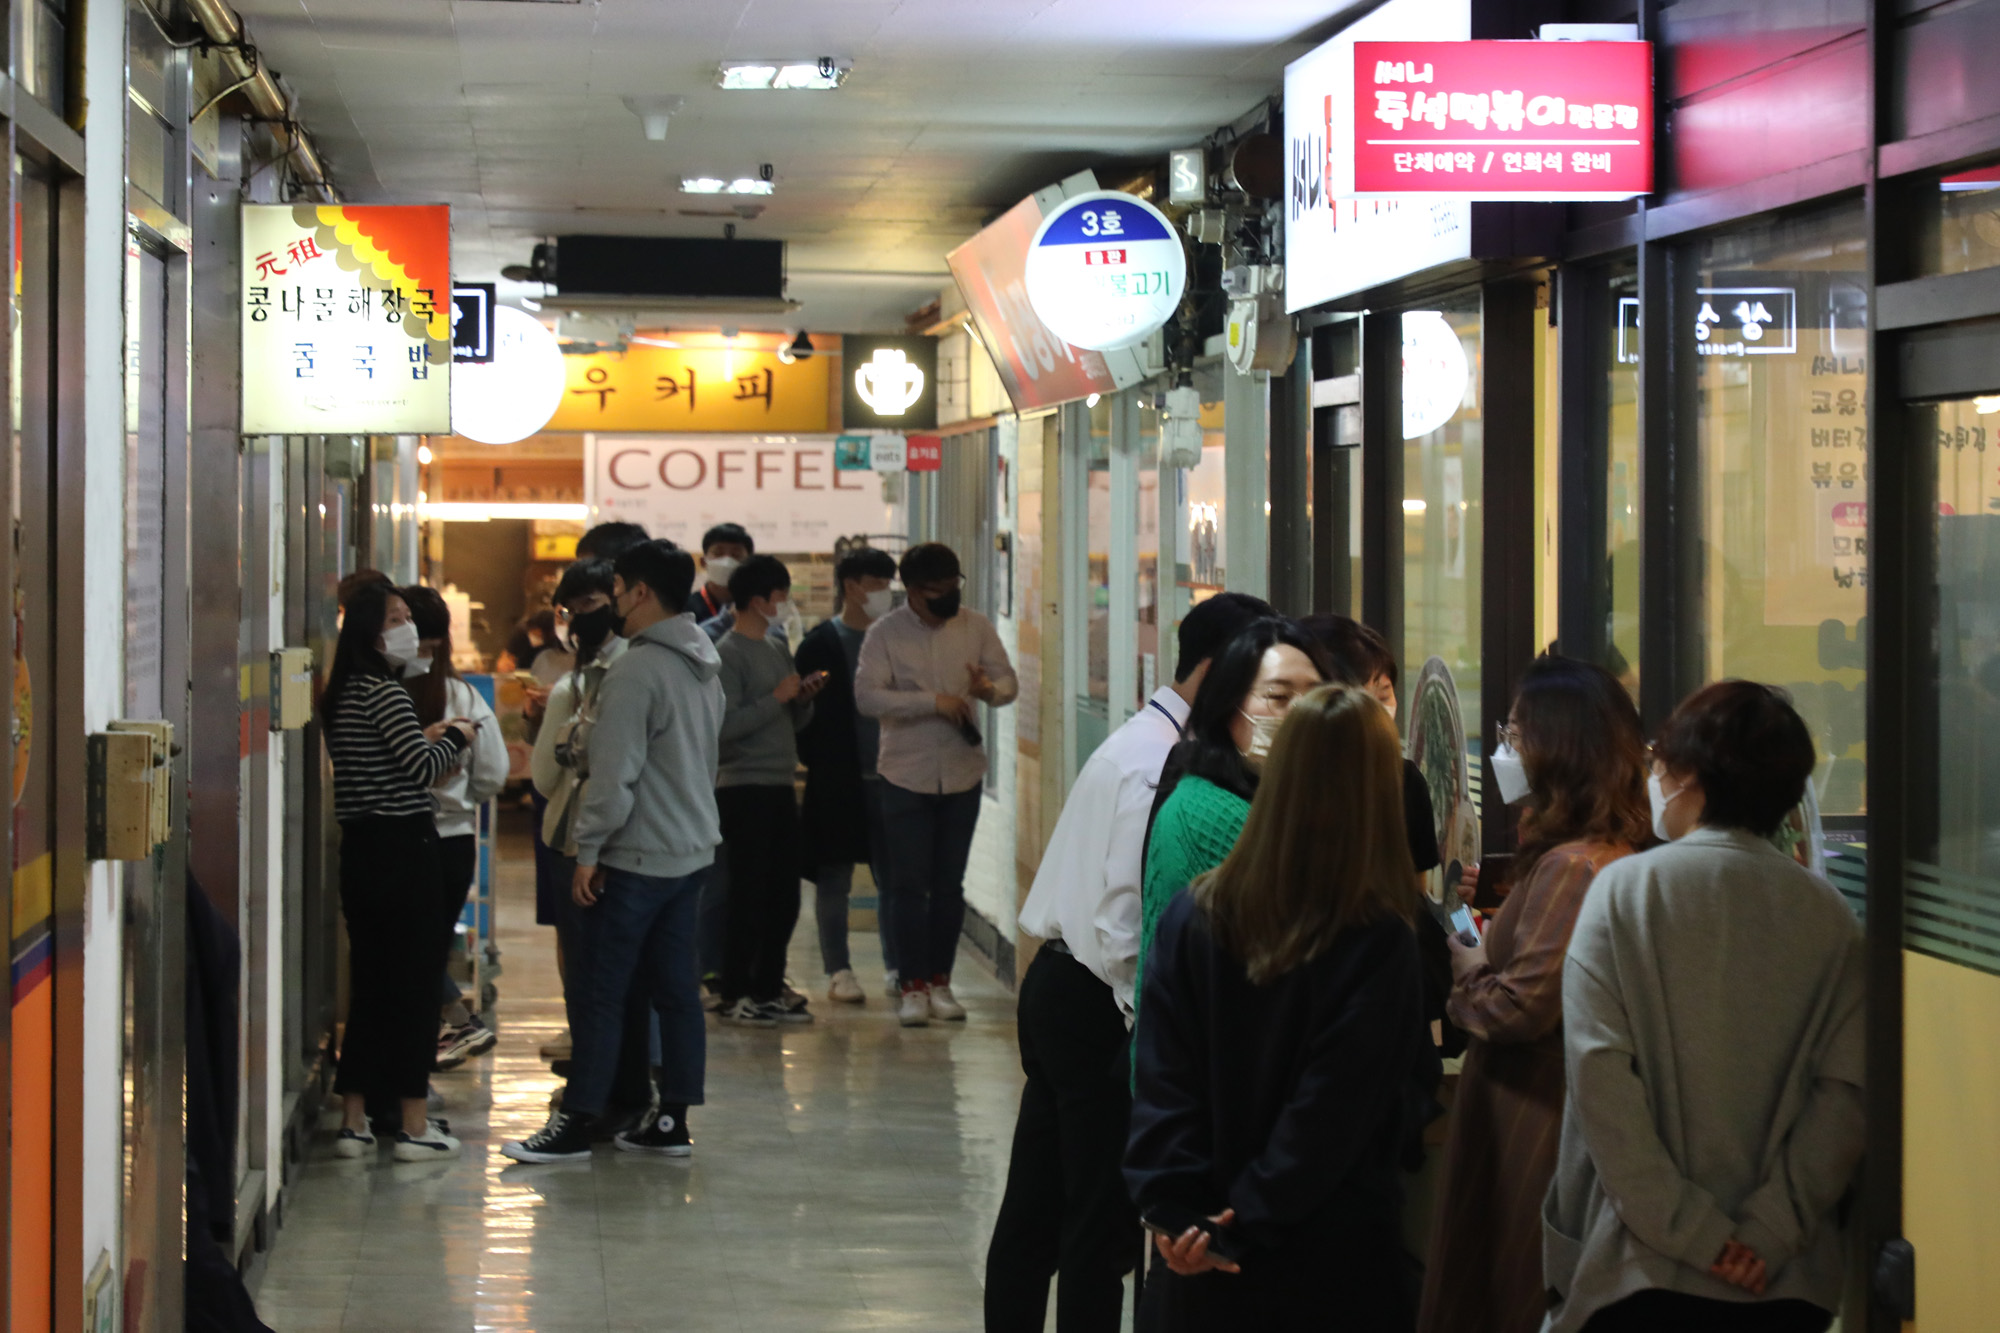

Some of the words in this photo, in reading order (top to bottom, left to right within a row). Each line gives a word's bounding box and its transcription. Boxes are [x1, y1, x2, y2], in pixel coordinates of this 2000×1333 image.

[1374, 61, 1433, 84] 써니
[1394, 152, 1476, 173] 단체예약
[1502, 152, 1563, 173] 연회석
[1571, 152, 1611, 173] 완비
[1081, 210, 1125, 237] 3호
[255, 236, 323, 281] 元祖
[247, 285, 437, 324] 콩나물해장국
[293, 343, 433, 380] 굴국밥
[1811, 461, 1866, 488] 볶음
